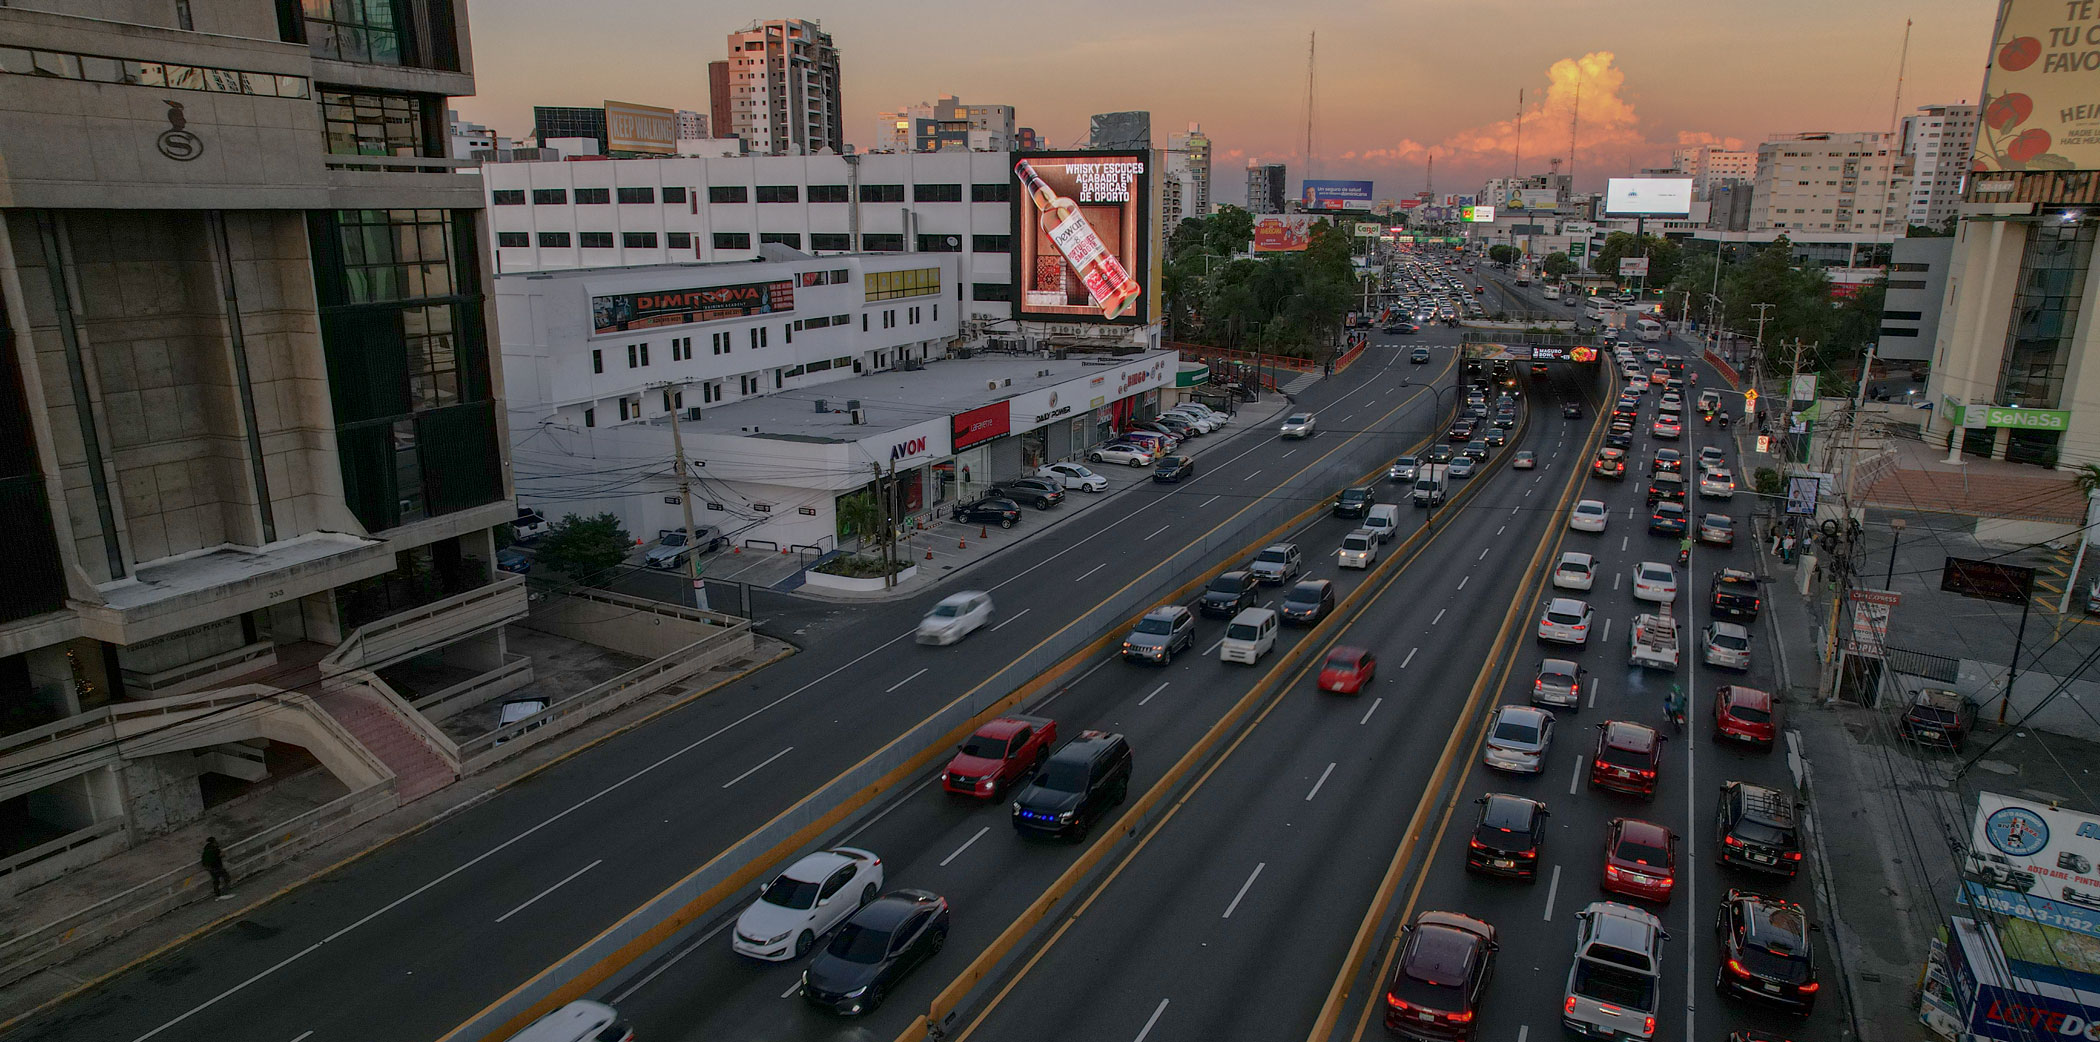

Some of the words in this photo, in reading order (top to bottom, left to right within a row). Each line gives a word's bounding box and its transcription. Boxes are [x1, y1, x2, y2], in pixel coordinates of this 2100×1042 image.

[2066, 0, 2093, 21] TE
[2049, 26, 2080, 47] TU
[612, 113, 634, 139] KEEP
[635, 117, 673, 141] WALKING
[1066, 164, 1101, 174] WHISKY
[1076, 174, 1118, 183] ACABADO
[1121, 174, 1133, 183] EN
[1082, 183, 1127, 192] BARRICAS
[1080, 192, 1092, 202] DE
[1094, 192, 1130, 202] OPORTO
[1036, 412, 1050, 423] DAILY
[1051, 405, 1071, 418] POWER
[1990, 410, 2061, 427] SeNaSa
[890, 435, 927, 460] AVON
[2027, 865, 2048, 876] AUTO
[2049, 869, 2068, 881] AIRE
